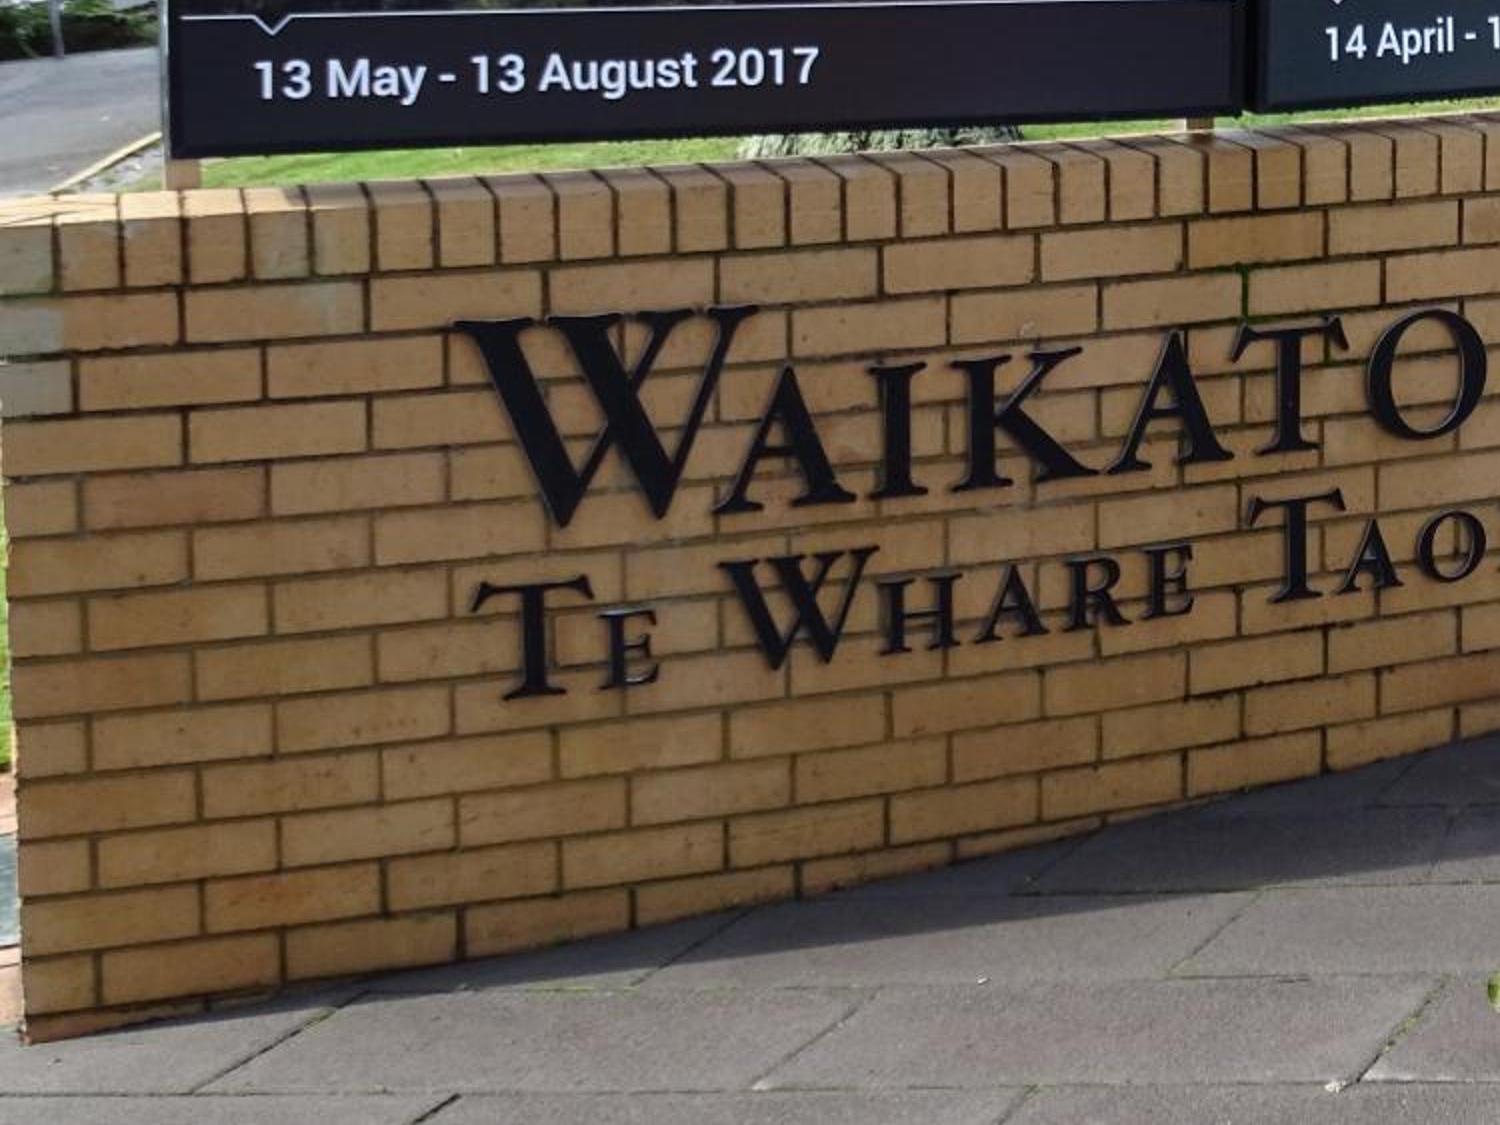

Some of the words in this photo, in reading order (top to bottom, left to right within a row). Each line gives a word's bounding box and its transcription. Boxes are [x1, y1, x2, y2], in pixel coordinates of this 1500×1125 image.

[255, 60, 311, 99] 13
[327, 59, 426, 105] May
[440, 73, 456, 83] -
[470, 56, 525, 93] 13
[539, 52, 697, 100] August
[711, 47, 818, 86] 2017
[1325, 25, 1367, 62] 14
[1376, 15, 1455, 65] April
[454, 305, 1487, 530] WAIKATO
[470, 574, 660, 701] TE
[717, 544, 1196, 672] WHARE
